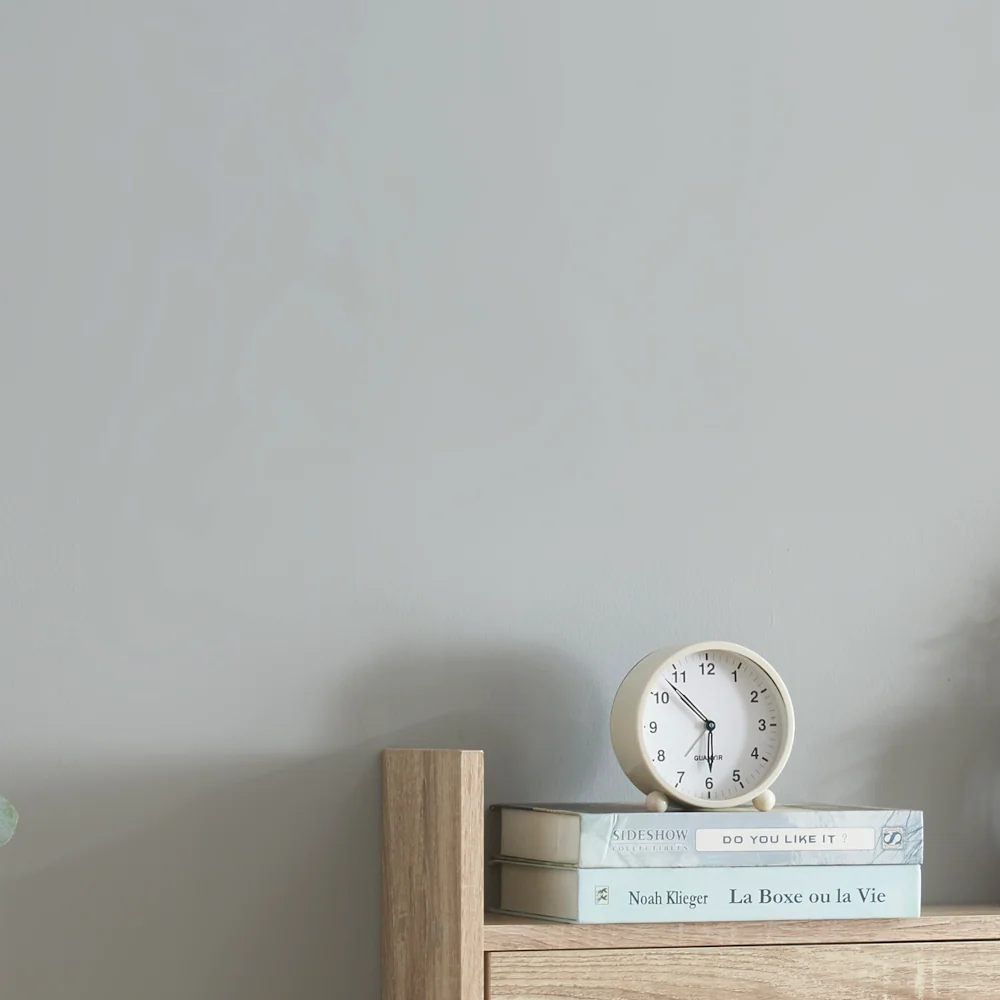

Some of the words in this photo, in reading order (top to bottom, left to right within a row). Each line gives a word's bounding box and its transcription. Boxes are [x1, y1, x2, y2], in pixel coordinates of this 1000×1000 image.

[699, 663, 715, 675] 12
[672, 671, 686, 683] 11
[732, 671, 738, 682] 1
[654, 692, 669, 704] 10
[751, 691, 759, 703] 2
[649, 721, 658, 733] 9
[758, 720, 767, 731] 3
[657, 750, 666, 762] 8
[750, 748, 759, 759] 4
[677, 772, 685, 783] 7
[732, 770, 741, 782] 5
[705, 777, 714, 790] 6
[612, 829, 688, 841] SIDESHOW
[723, 835, 743, 844] DO
[750, 835, 780, 844] YOU
[784, 834, 816, 844] LIKE
[822, 834, 836, 844] IT
[841, 833, 848, 844] ?
[628, 891, 662, 905] Noah
[666, 890, 708, 909] Klieger
[728, 888, 752, 904] La
[758, 888, 803, 904] Boxe
[809, 892, 830, 904] ou
[836, 888, 852, 904] la
[857, 887, 886, 903] Vie
